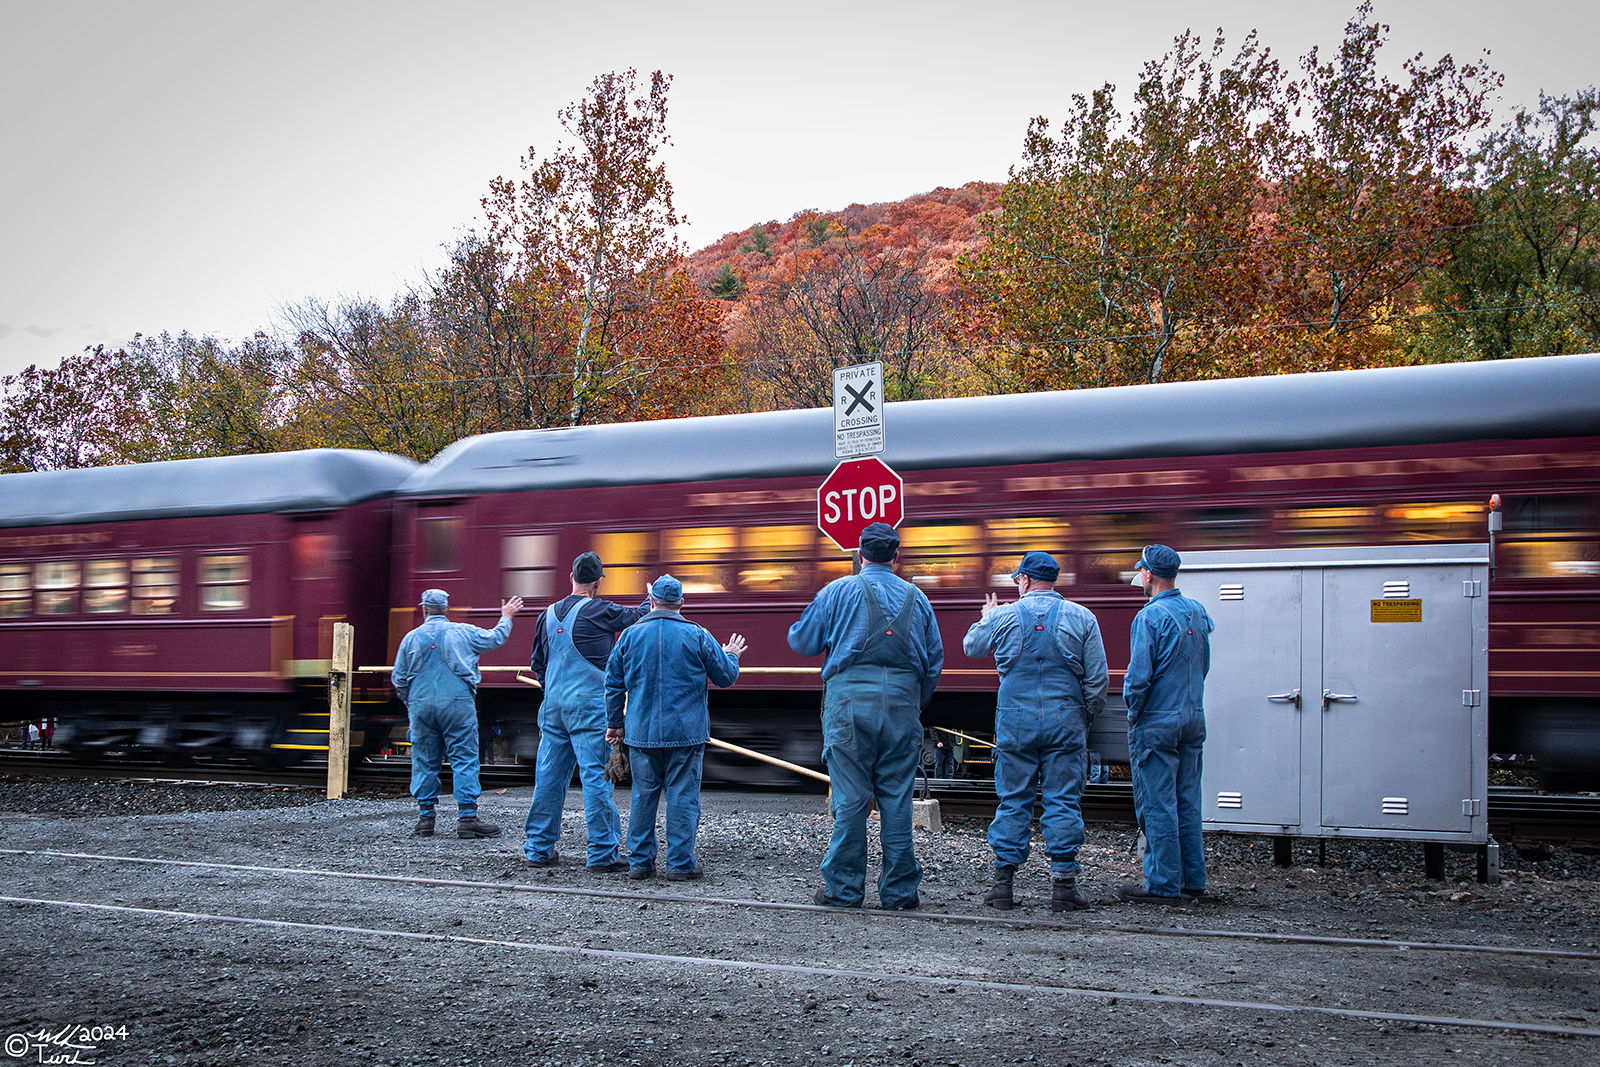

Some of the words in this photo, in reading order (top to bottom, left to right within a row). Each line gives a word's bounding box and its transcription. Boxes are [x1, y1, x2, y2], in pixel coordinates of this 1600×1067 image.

[840, 367, 876, 381] PRIVATE
[841, 396, 847, 405] R
[870, 391, 876, 400] R
[841, 415, 878, 427] CROSSING
[846, 428, 882, 440] TRESPASSING
[824, 484, 896, 524] STOP
